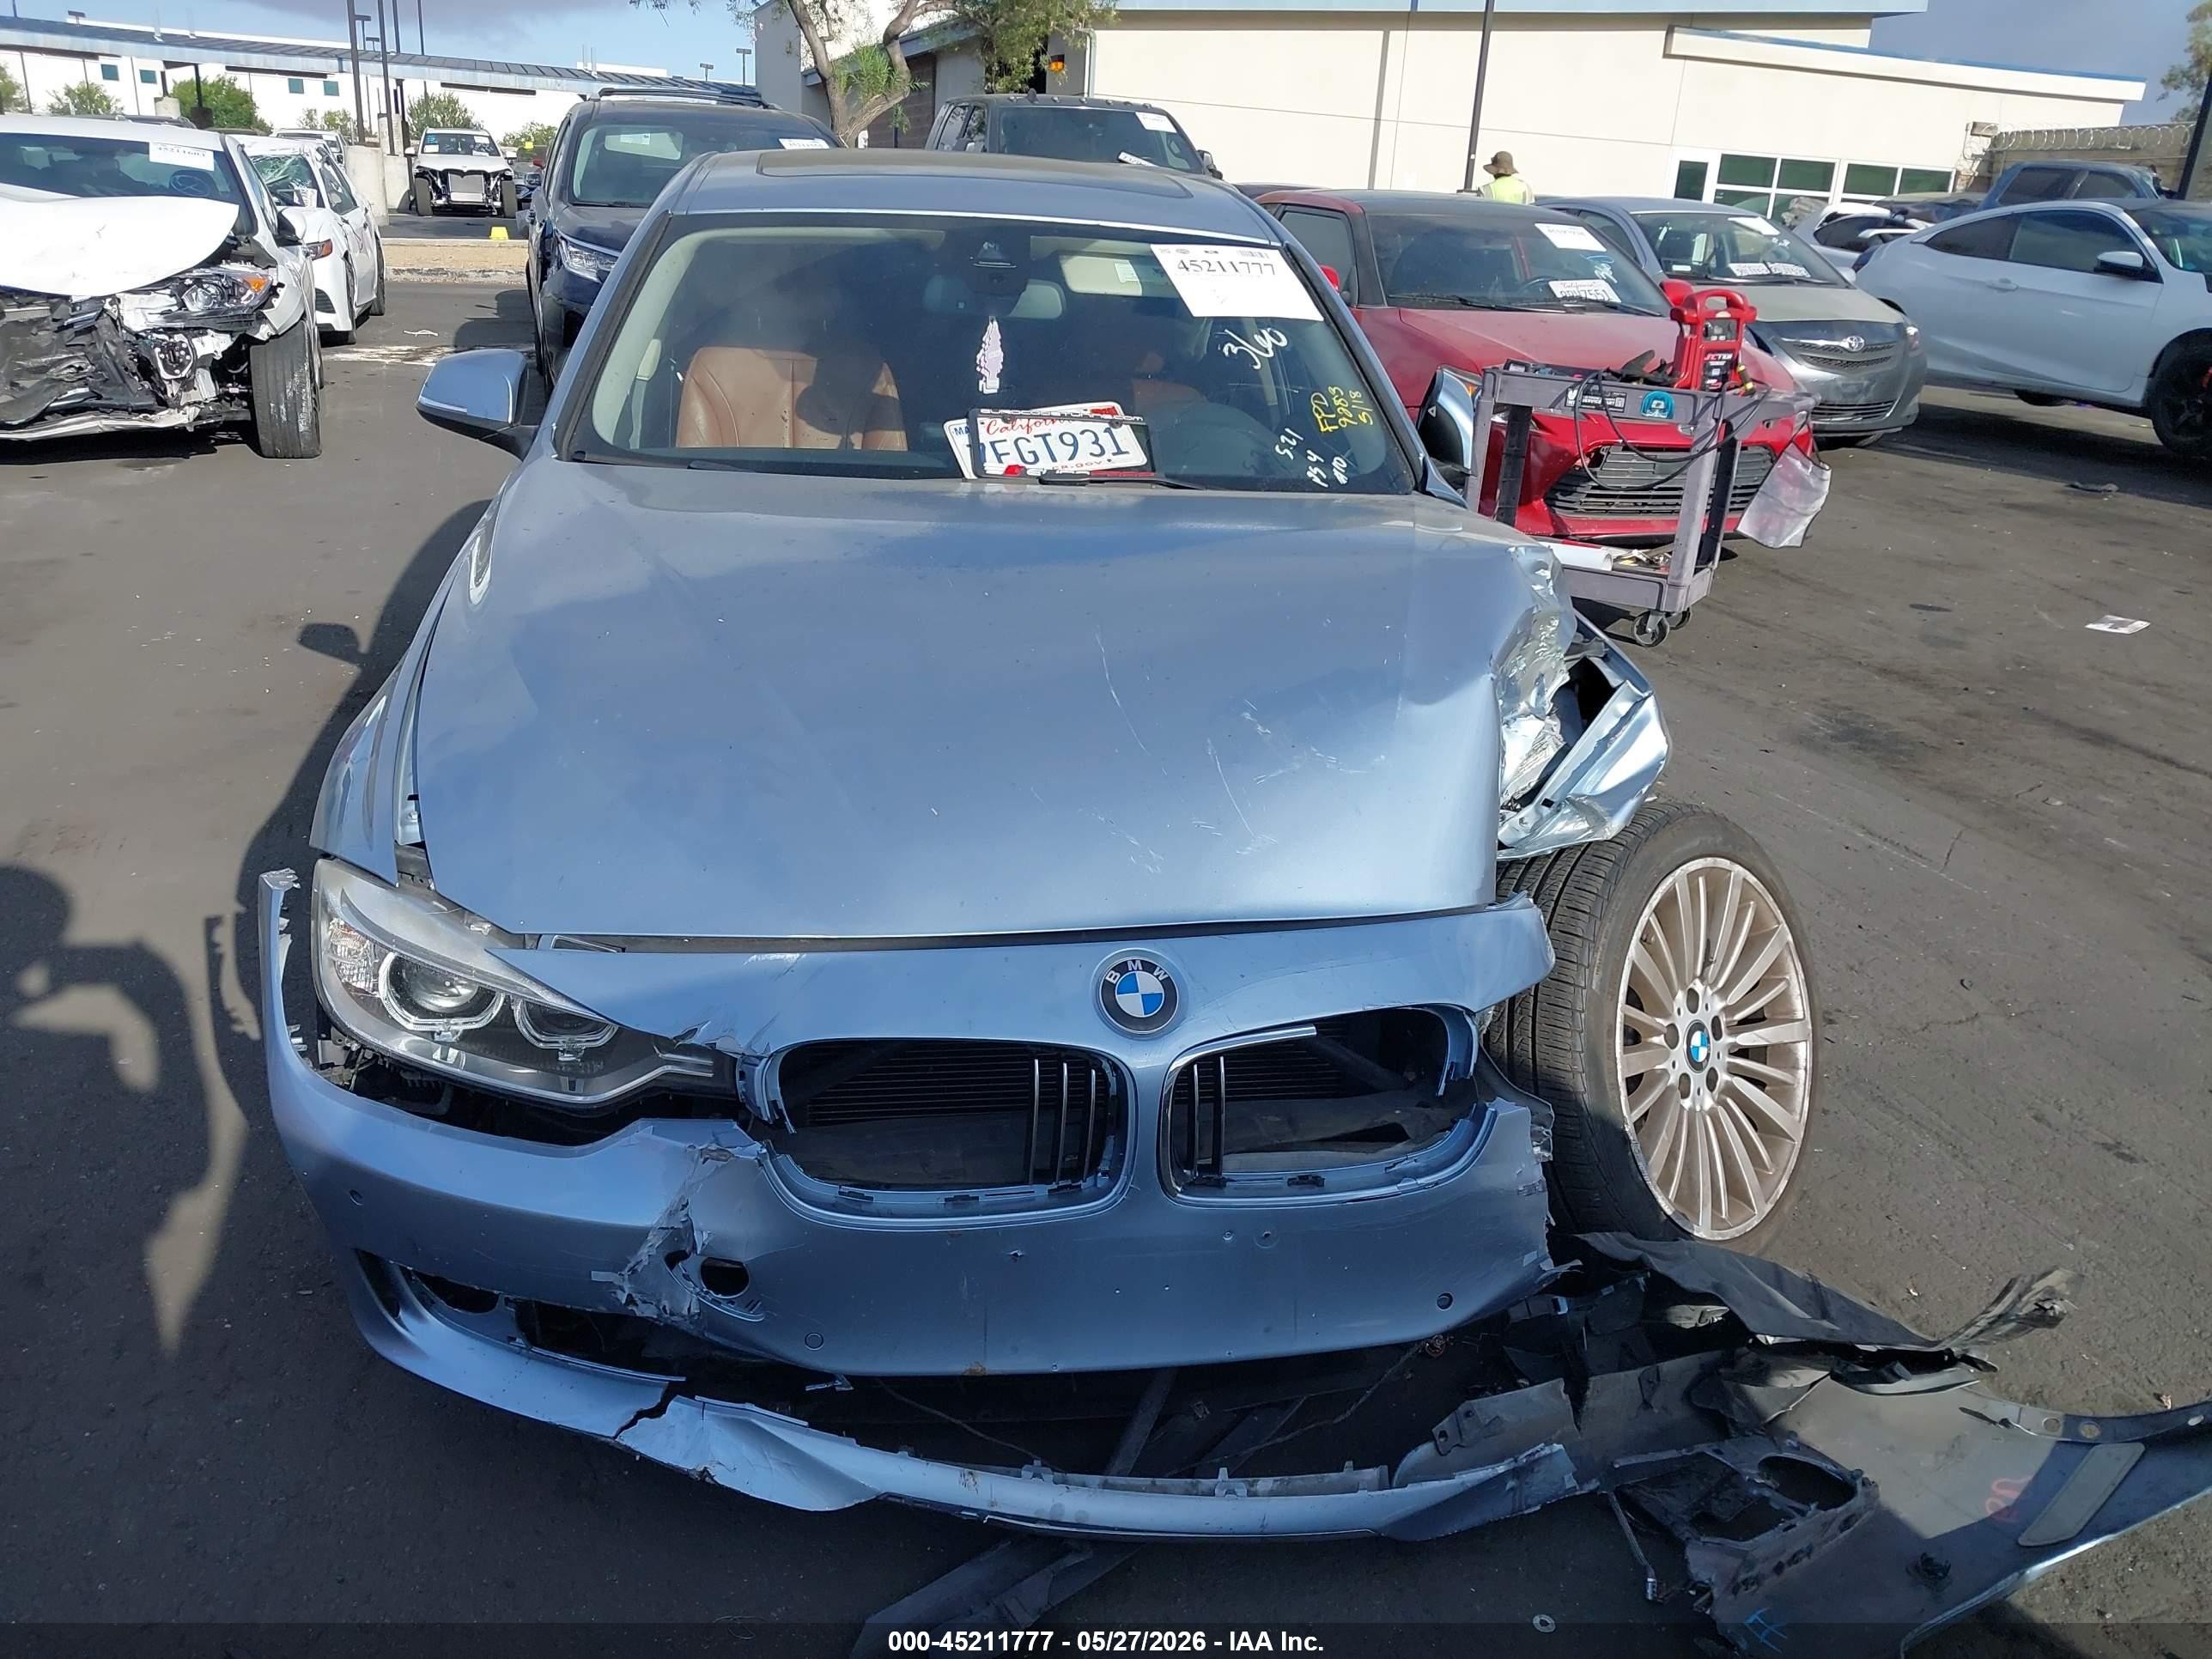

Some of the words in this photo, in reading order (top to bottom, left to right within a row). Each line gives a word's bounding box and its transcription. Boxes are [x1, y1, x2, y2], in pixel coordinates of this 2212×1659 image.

[1177, 259, 1275, 275] 45211777
[1275, 428, 1304, 460] 5.21
[1105, 959, 1169, 984] BMW
